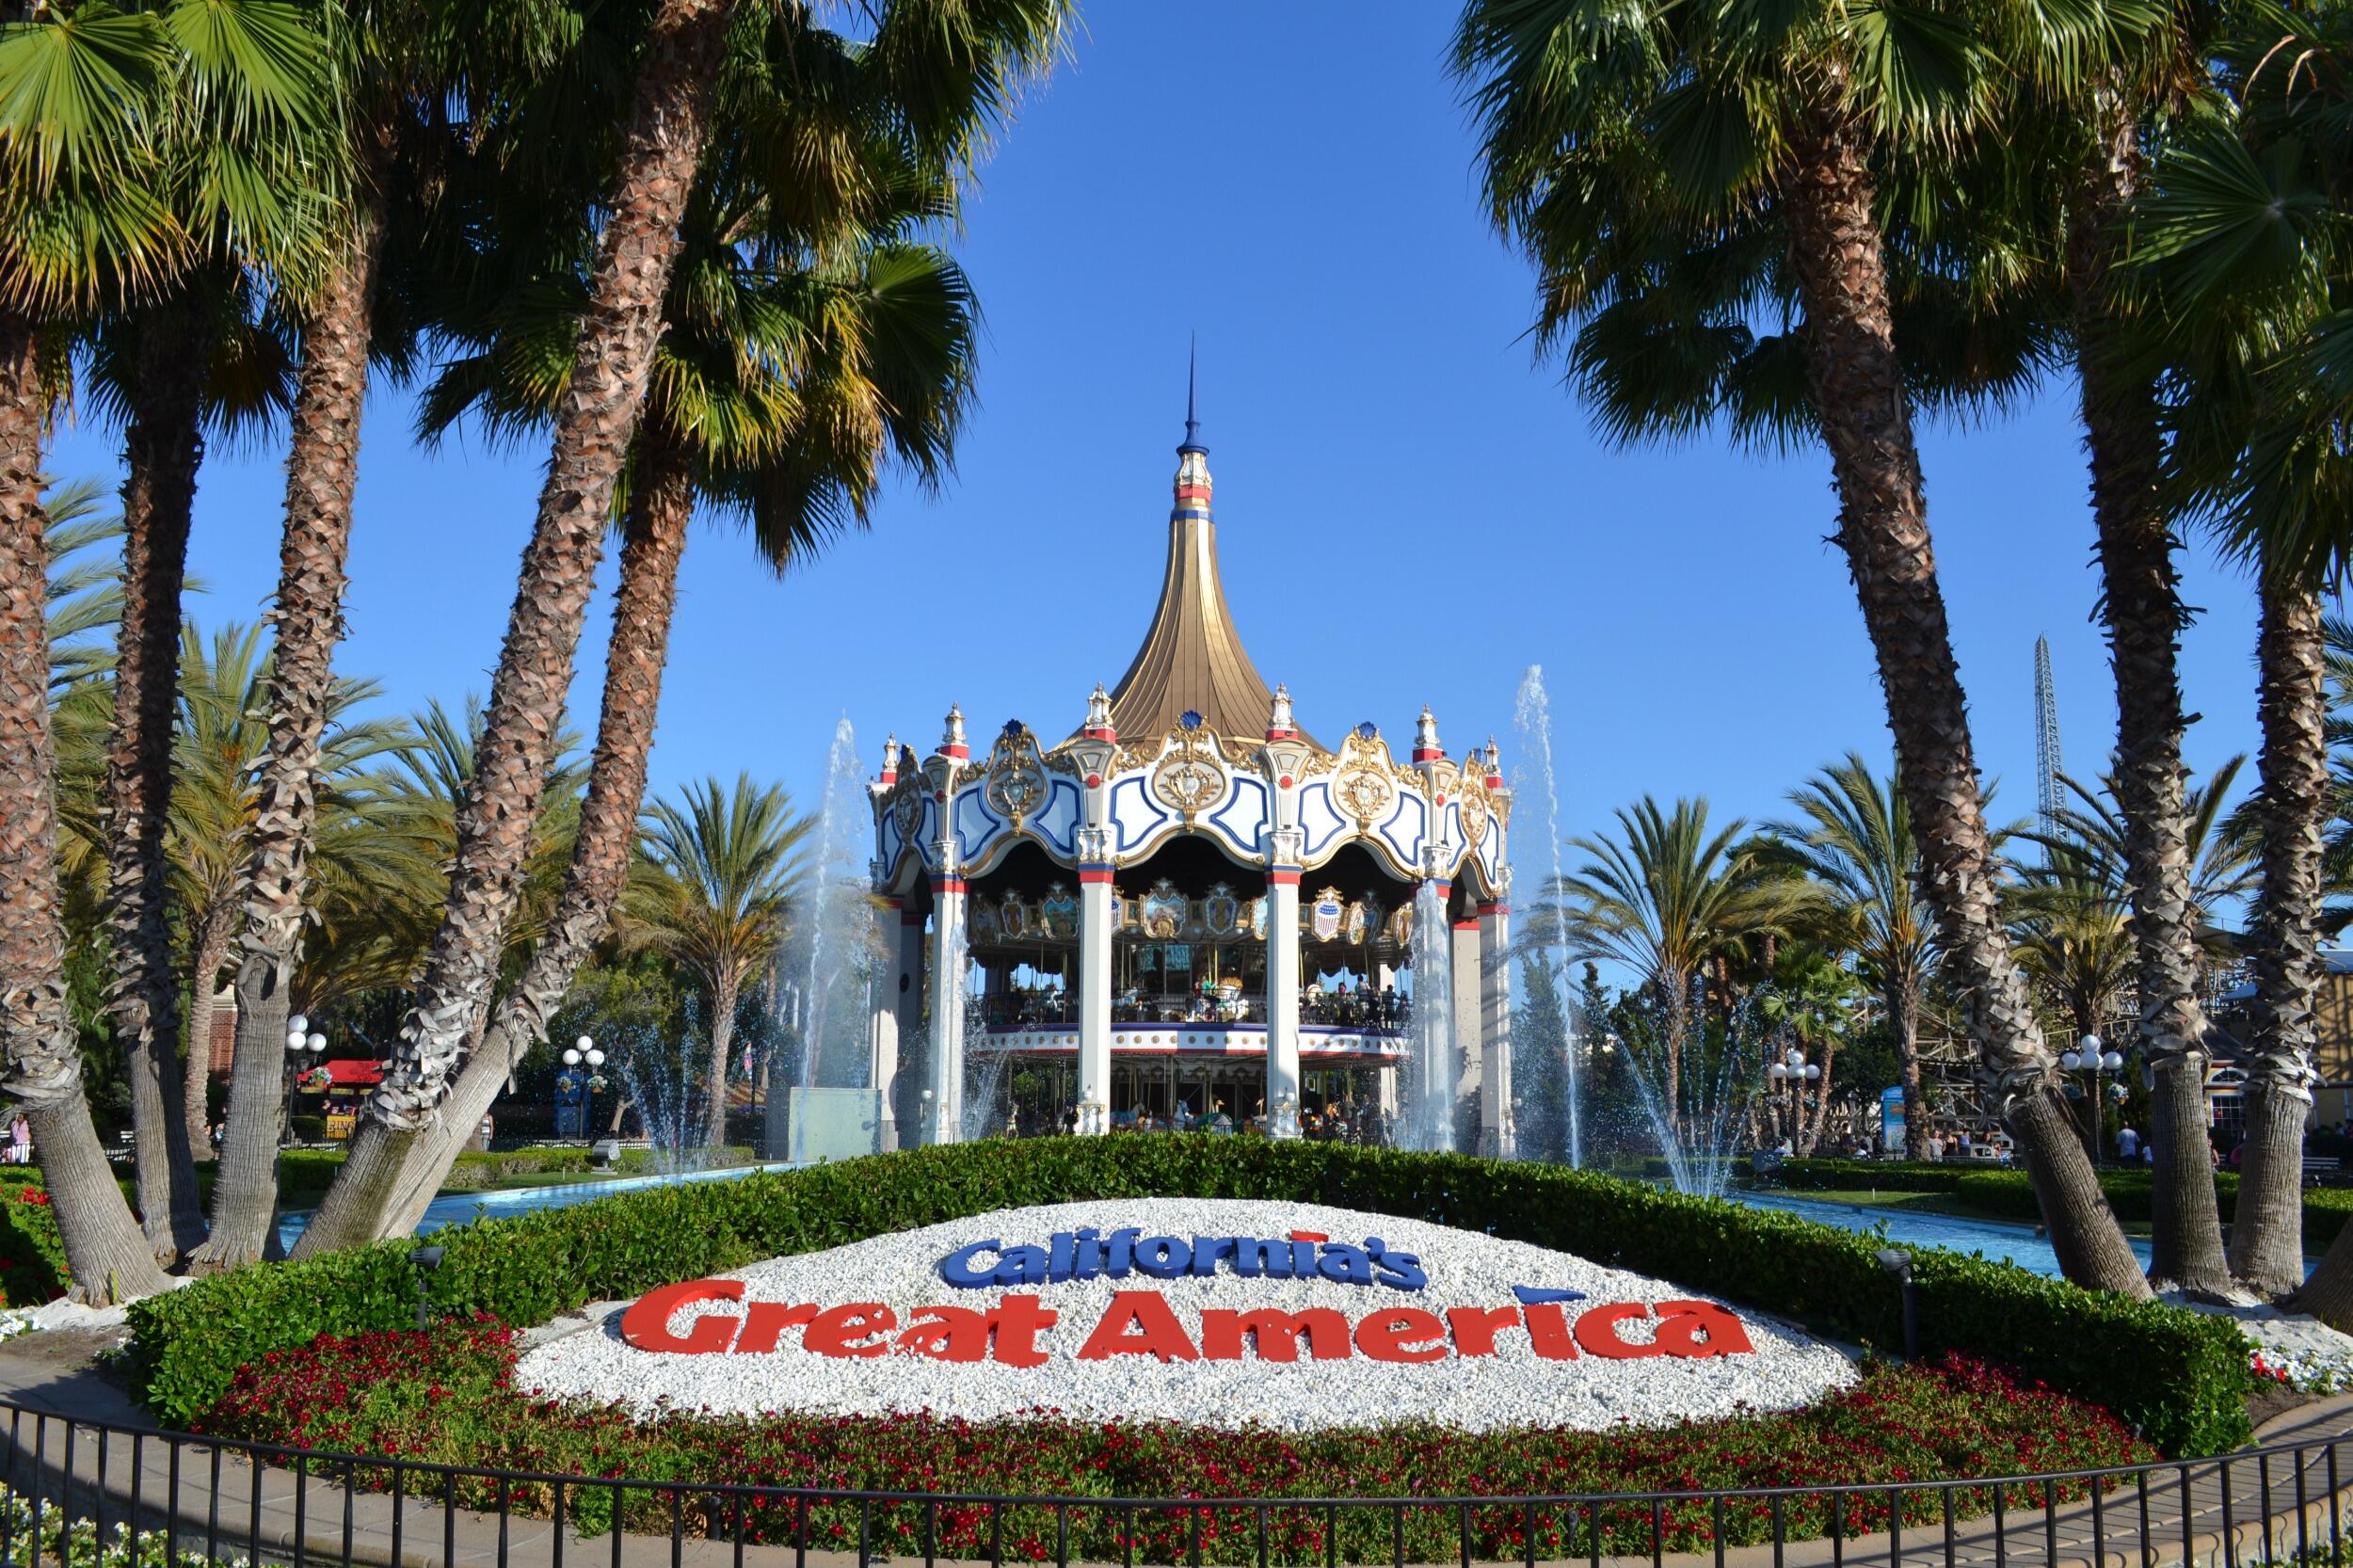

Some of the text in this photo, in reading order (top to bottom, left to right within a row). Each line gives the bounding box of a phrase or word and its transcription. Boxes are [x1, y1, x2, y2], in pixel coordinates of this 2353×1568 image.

[942, 1227, 1428, 1291] California's
[621, 1279, 1756, 1368] Great America
